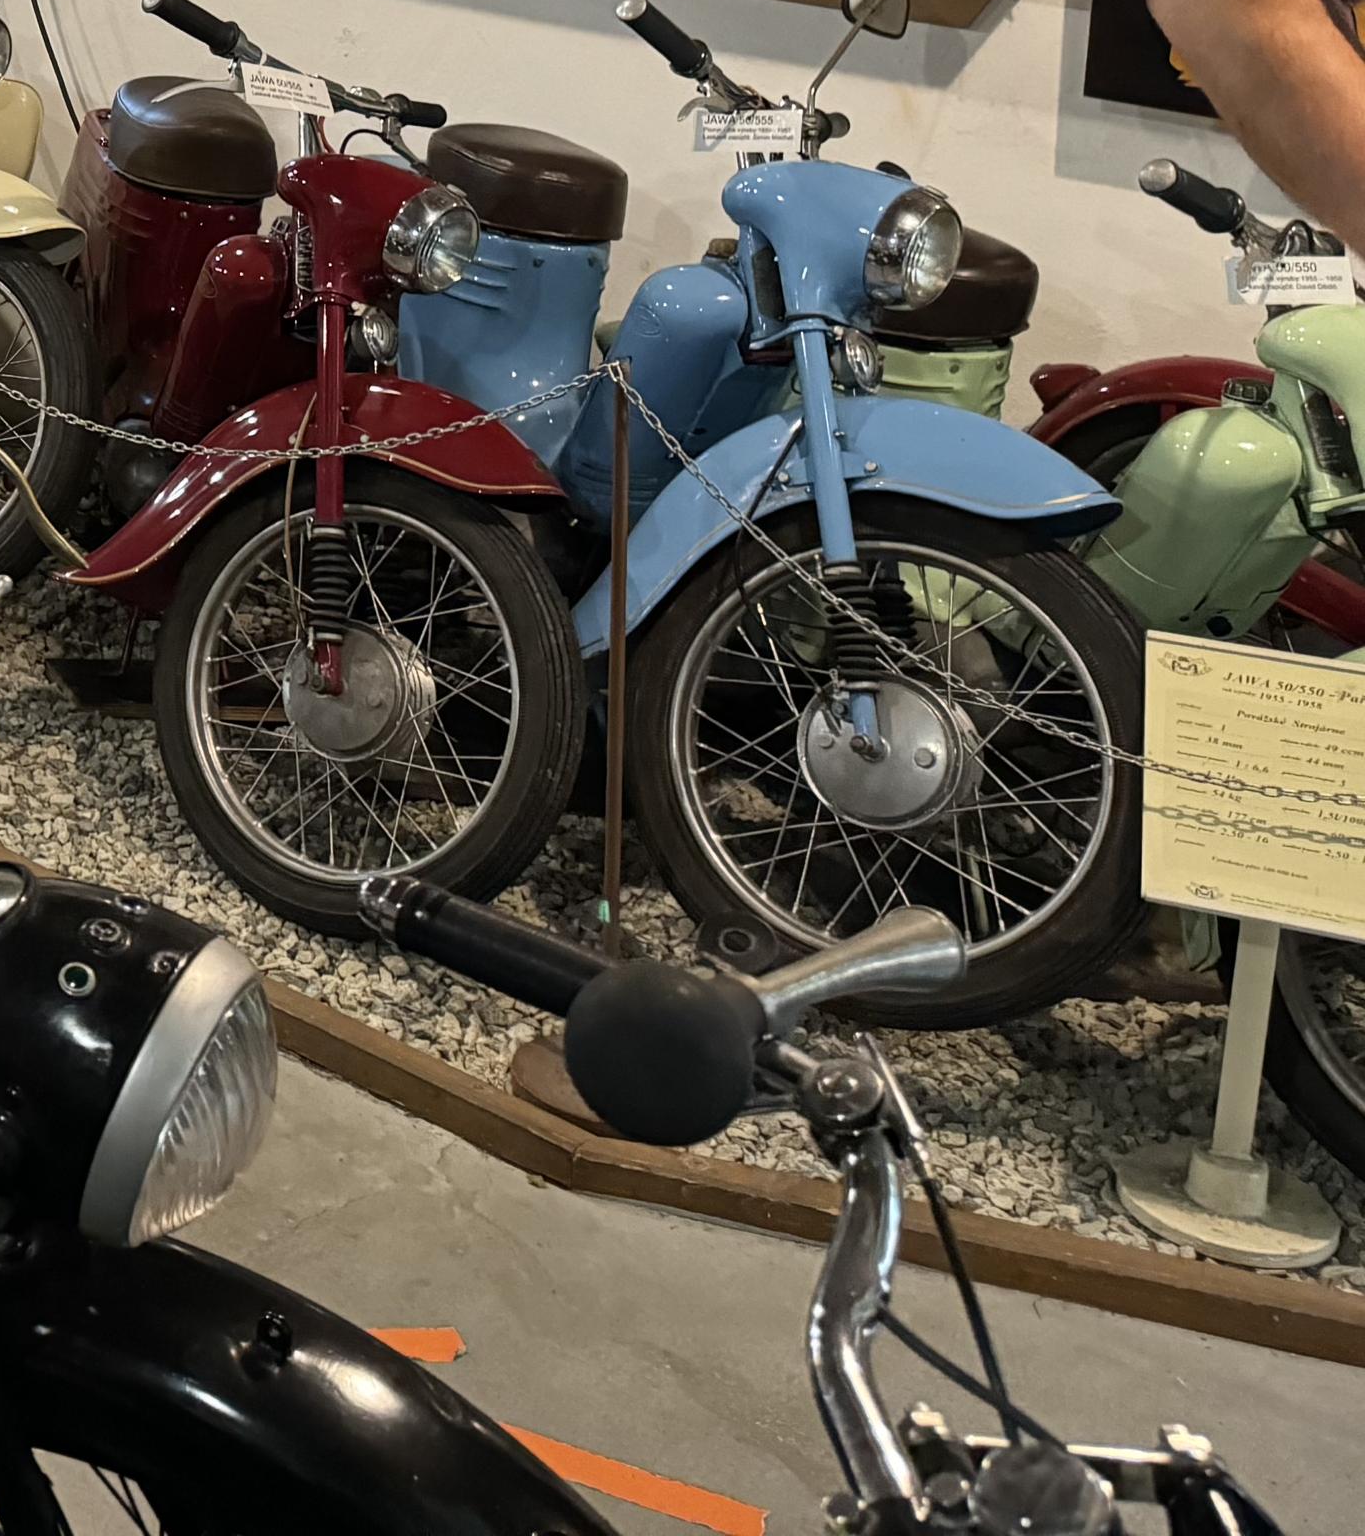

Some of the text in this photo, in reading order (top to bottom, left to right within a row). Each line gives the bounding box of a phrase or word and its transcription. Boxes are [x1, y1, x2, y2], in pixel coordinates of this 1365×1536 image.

[250, 73, 275, 86] JAWA
[704, 114, 736, 125] JAWA
[1222, 671, 1270, 689] JAWA
[1275, 679, 1325, 698] 50/550
